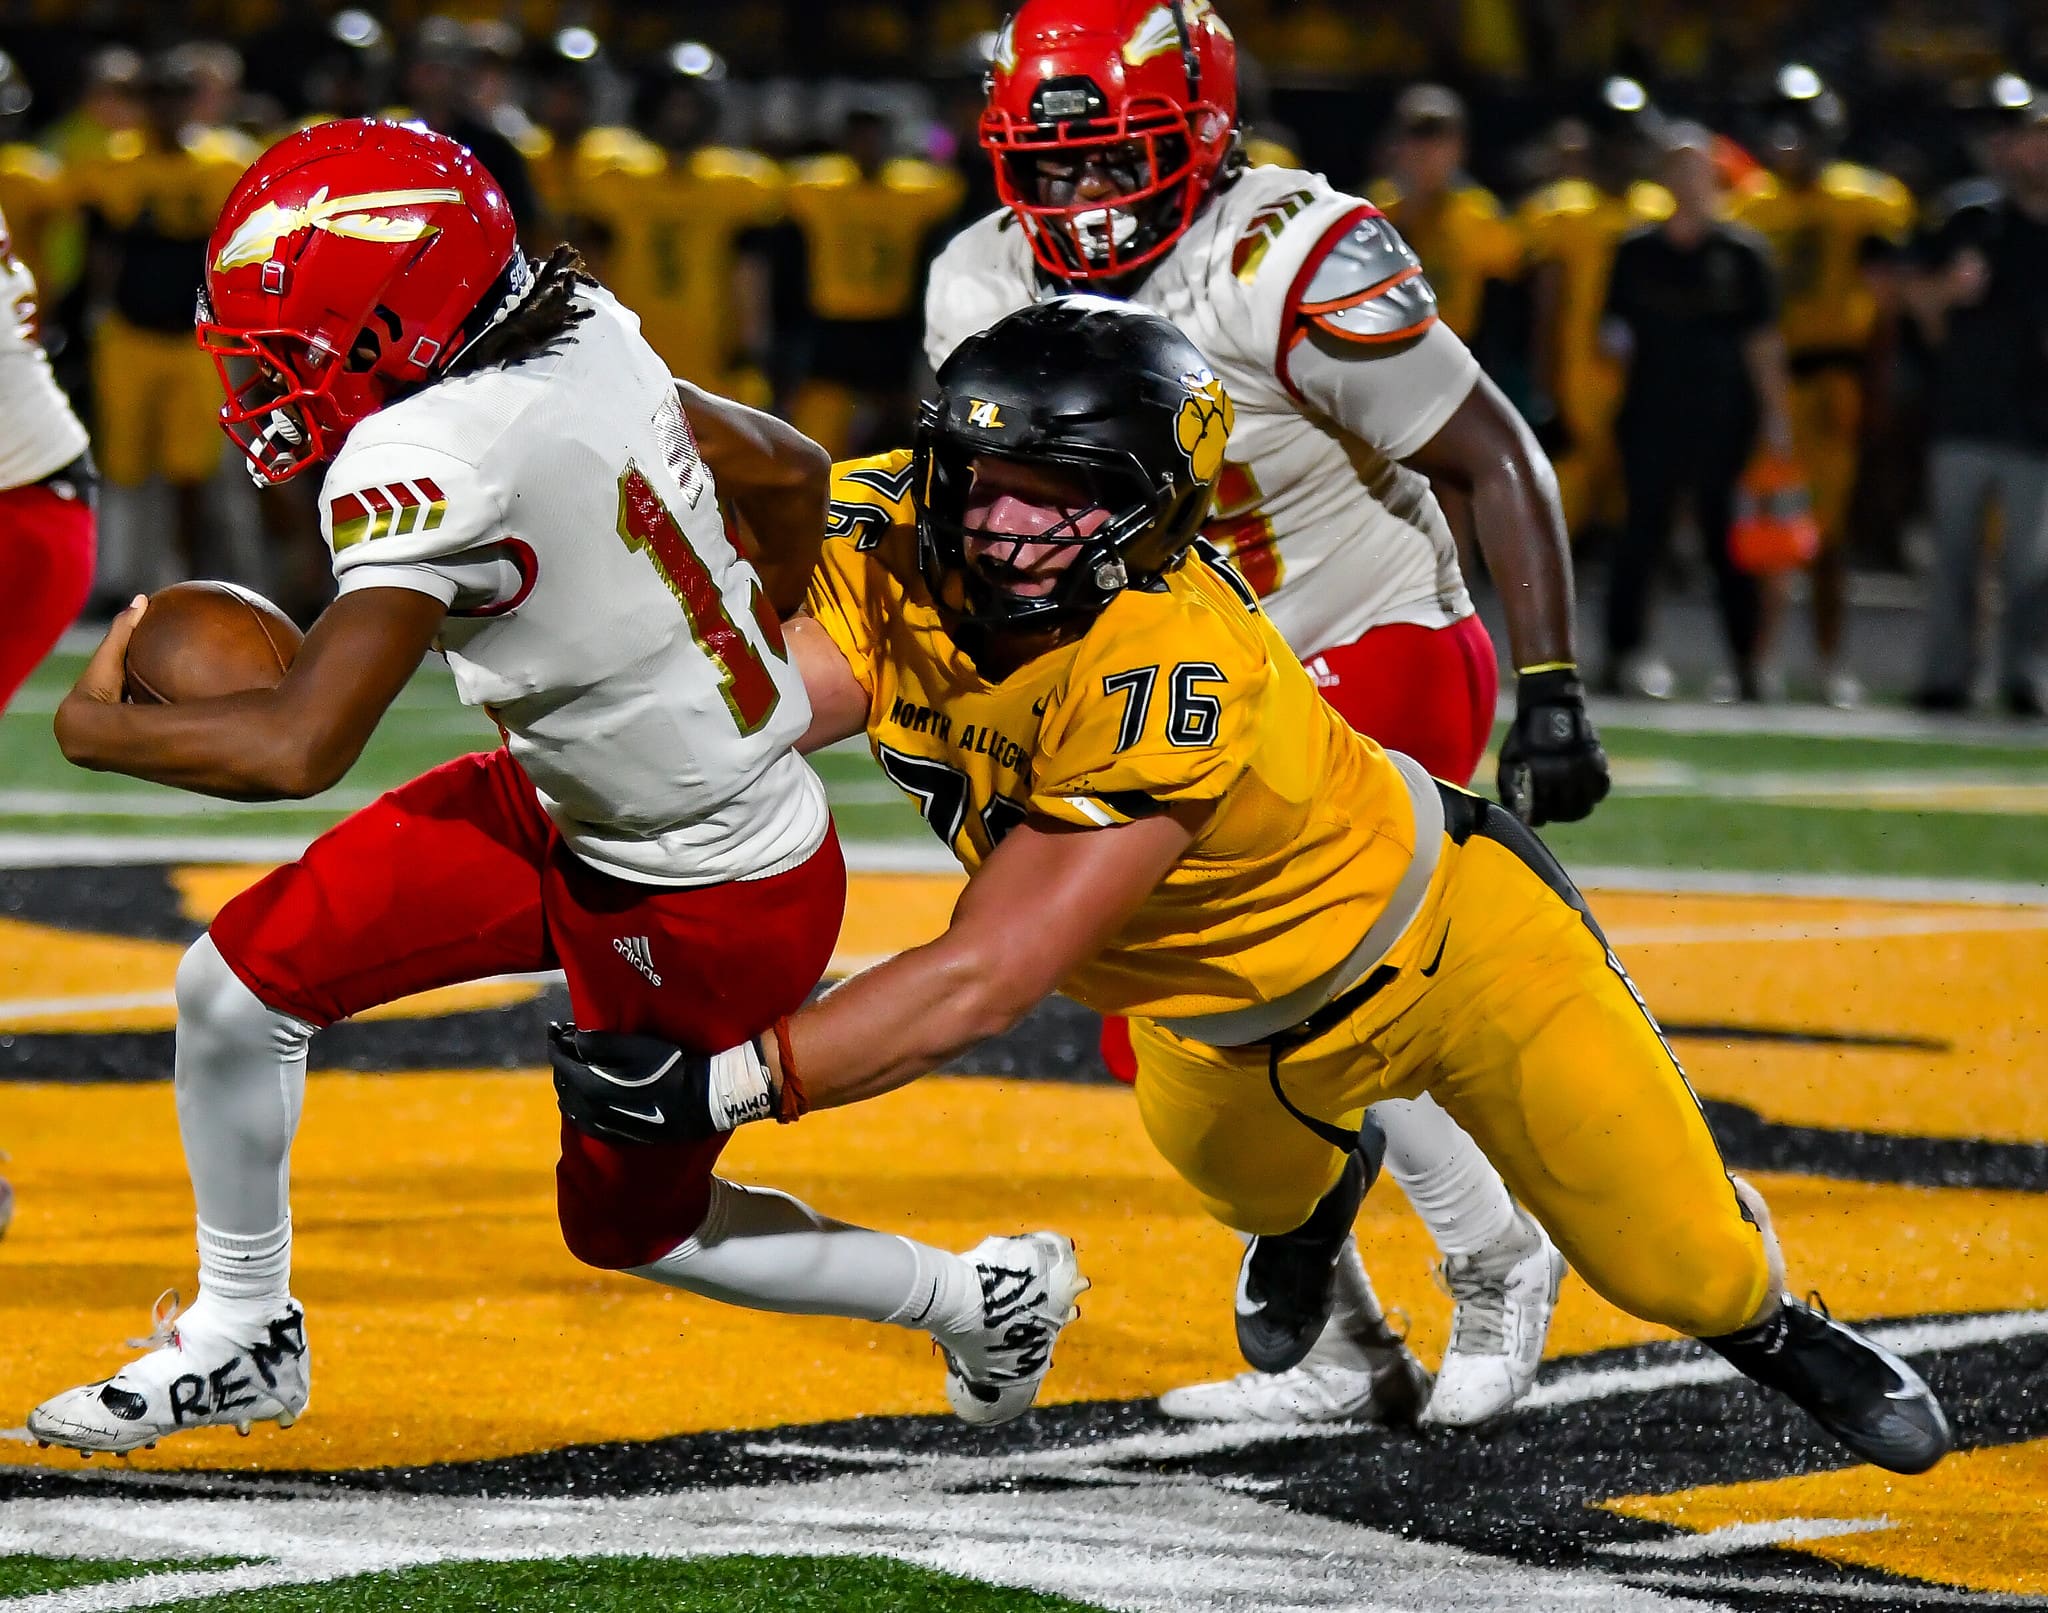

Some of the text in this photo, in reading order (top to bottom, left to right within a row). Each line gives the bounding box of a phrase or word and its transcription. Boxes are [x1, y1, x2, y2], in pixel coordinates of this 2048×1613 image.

[967, 400, 1006, 428] T4L
[617, 388, 790, 738] 1
[889, 695, 952, 743] NORTH
[1102, 661, 1229, 754] 76
[879, 740, 1030, 862] 7
[613, 938, 662, 987] adidas
